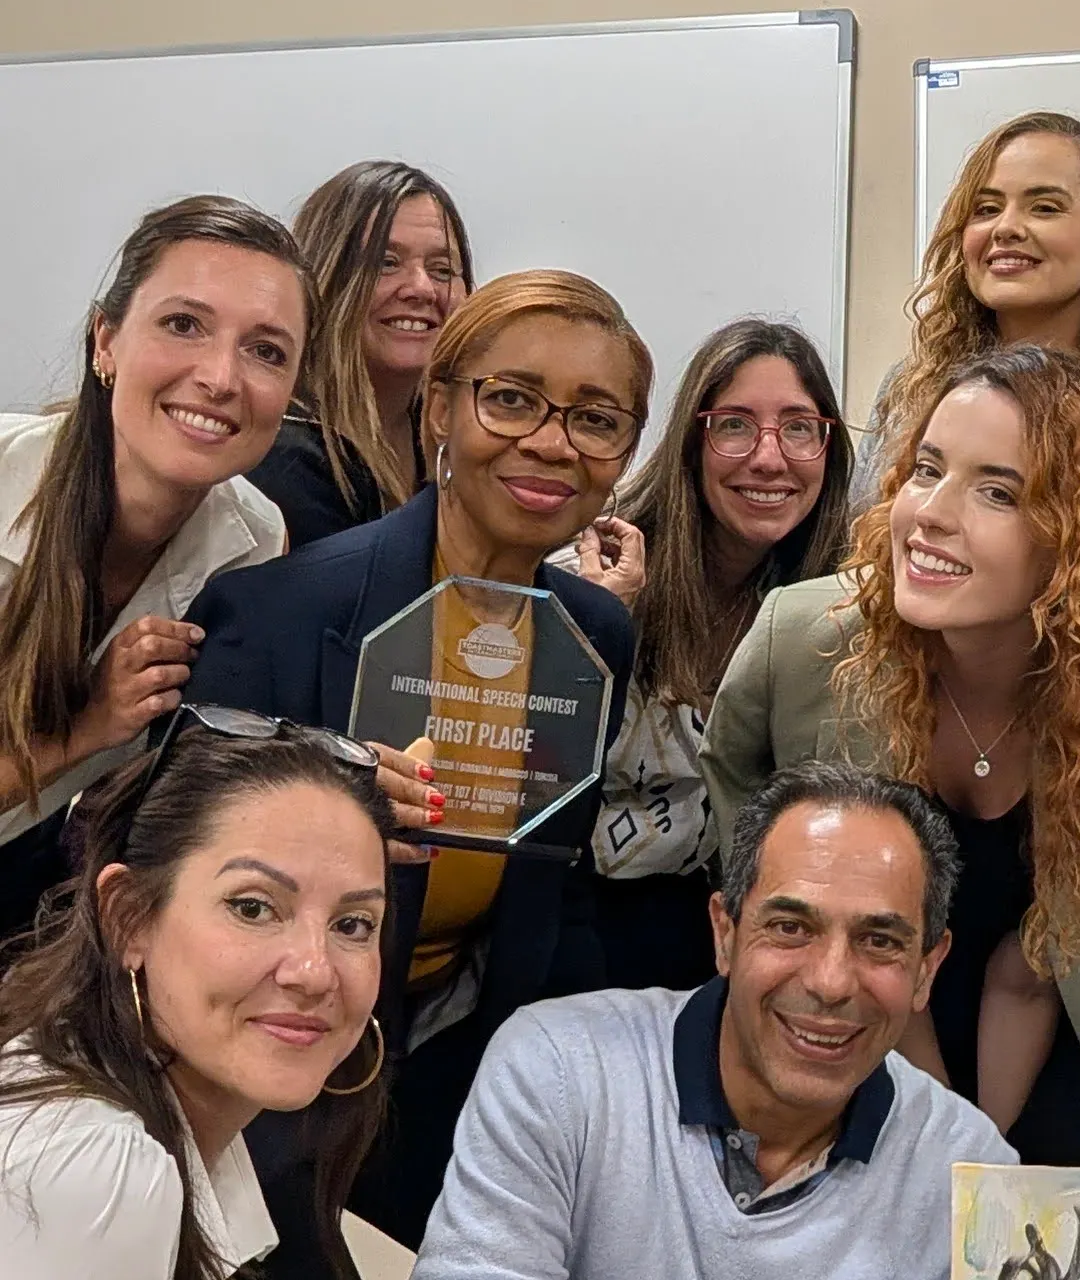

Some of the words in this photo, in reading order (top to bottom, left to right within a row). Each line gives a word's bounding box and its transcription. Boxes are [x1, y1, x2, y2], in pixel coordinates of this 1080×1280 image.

[391, 674, 480, 704] INTERNATIONAL
[482, 688, 527, 710] SPEECH
[528, 694, 579, 717] CONTEST
[424, 715, 476, 746] FIRST
[477, 722, 536, 754] PLACE
